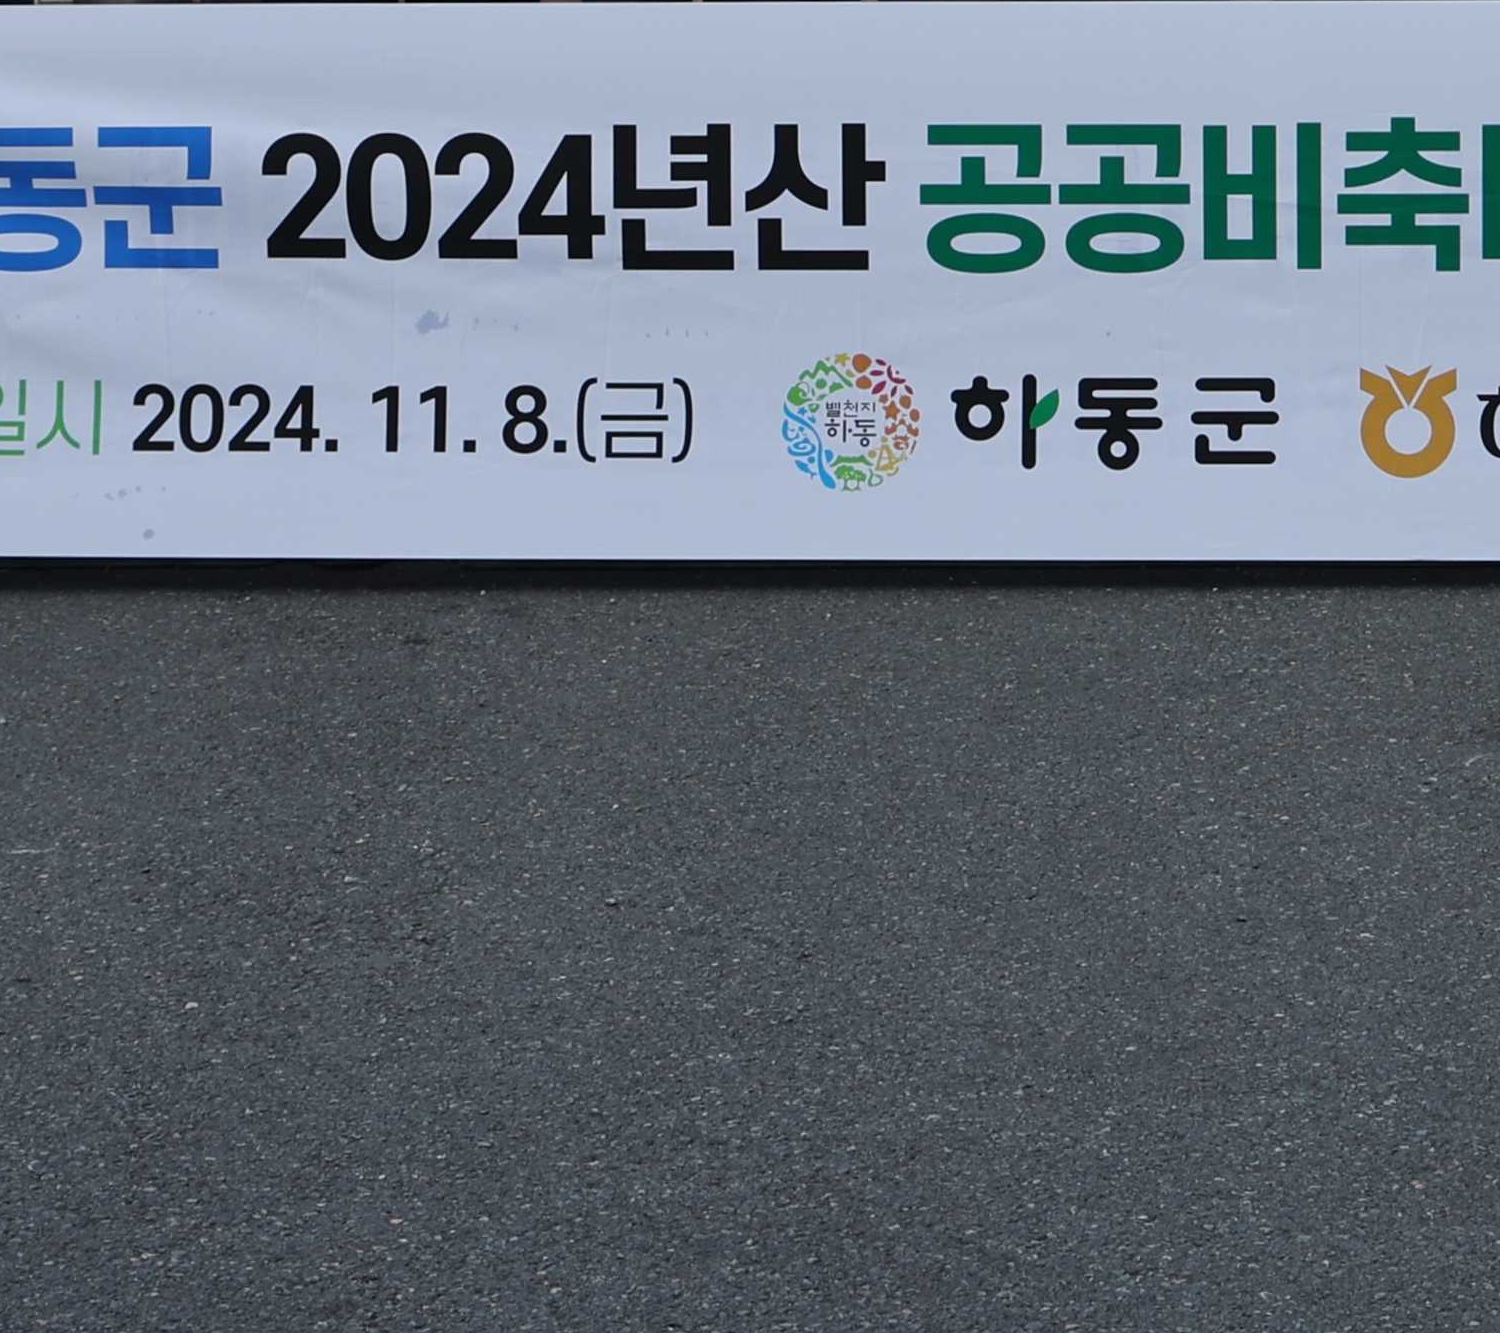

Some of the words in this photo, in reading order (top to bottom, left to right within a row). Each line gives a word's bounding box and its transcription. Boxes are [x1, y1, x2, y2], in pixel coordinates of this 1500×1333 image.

[262, 122, 887, 271] 2024년산
[133, 383, 339, 453] 2024.
[372, 385, 477, 453] 11.
[502, 377, 693, 464] 8.(금)
[824, 418, 877, 448] 하동
[825, 400, 876, 418] 별천지
[951, 374, 1279, 470] 하동군
